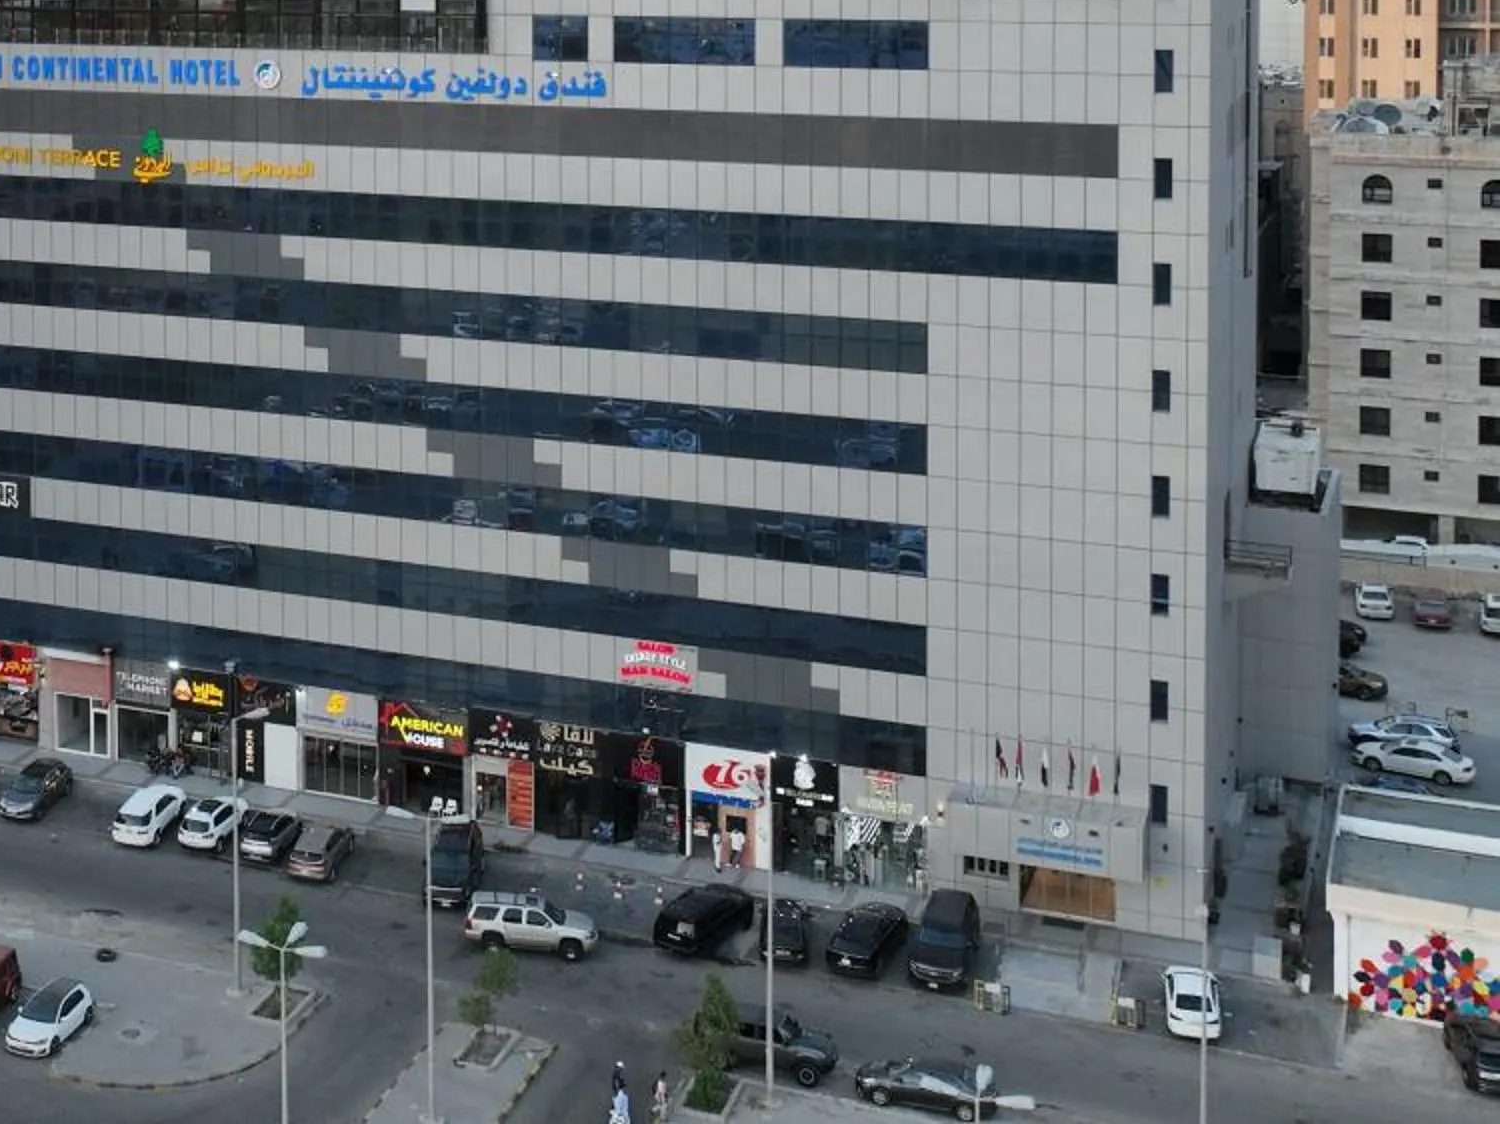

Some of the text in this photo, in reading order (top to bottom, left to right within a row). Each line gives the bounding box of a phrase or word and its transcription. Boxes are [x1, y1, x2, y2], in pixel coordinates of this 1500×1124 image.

[11, 54, 159, 84] CONTINENTAL
[170, 59, 241, 87] HOTEL
[445, 67, 527, 101] دولفين
[538, 71, 607, 101] فندق
[390, 715, 464, 738] AMERICAN
